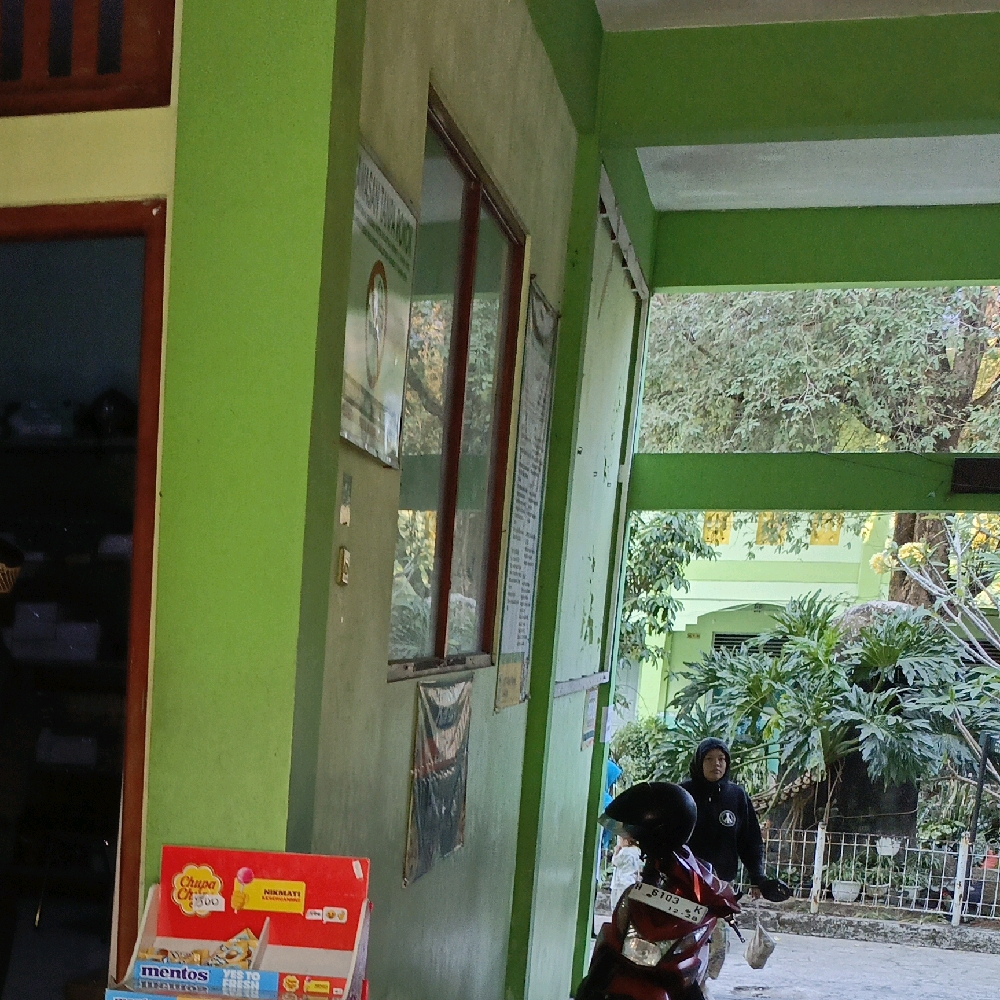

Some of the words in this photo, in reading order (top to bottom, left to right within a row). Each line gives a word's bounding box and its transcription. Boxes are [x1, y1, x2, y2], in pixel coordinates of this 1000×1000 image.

[180, 876, 216, 891] Chupa
[634, 883, 643, 891] H
[651, 889, 680, 904] 6103
[694, 905, 703, 915] K
[141, 966, 208, 981] mentos
[223, 968, 244, 979] YES
[246, 970, 260, 980] TO
